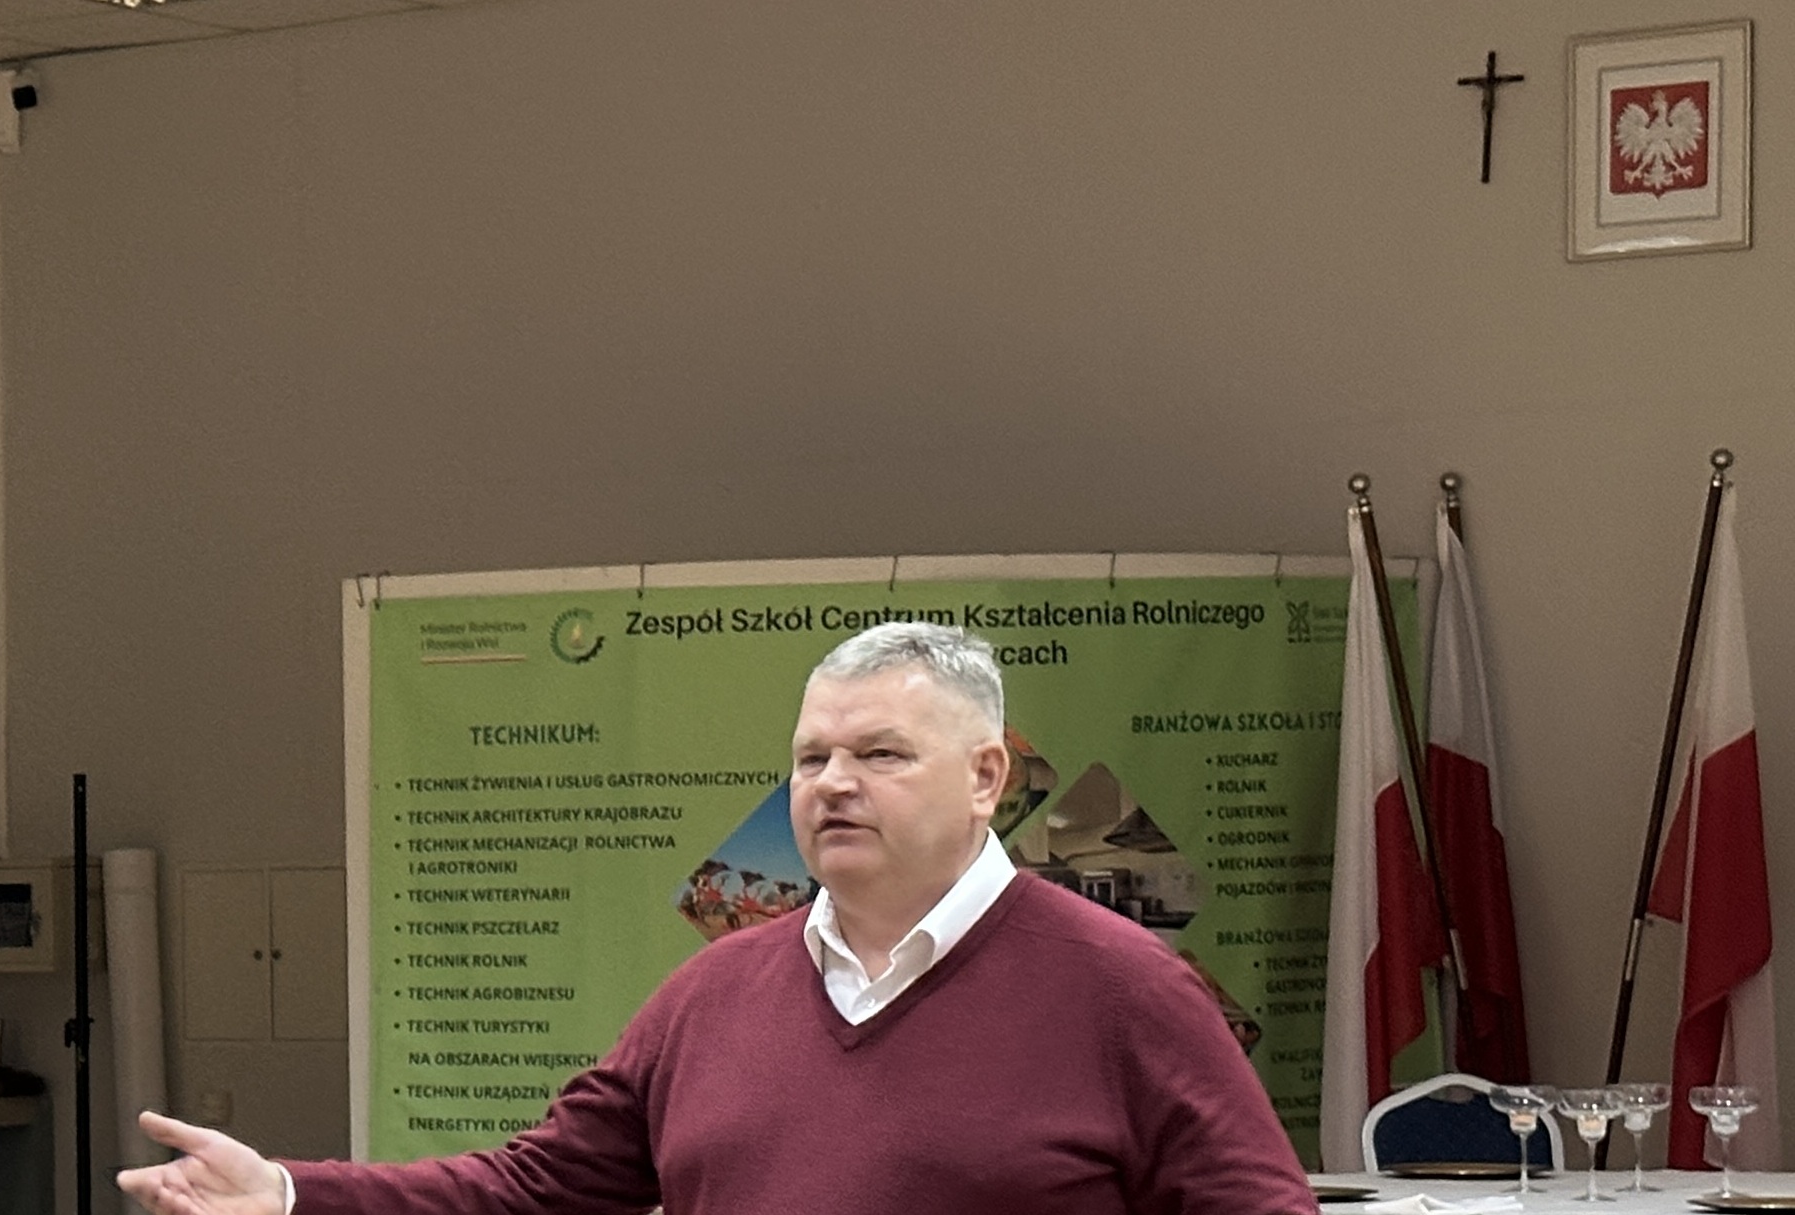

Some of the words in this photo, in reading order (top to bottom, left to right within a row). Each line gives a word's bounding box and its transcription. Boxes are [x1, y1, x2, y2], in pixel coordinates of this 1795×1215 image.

[626, 607, 723, 639] Zespół
[731, 606, 812, 632] Szkół
[963, 601, 1126, 628] Kształcenia
[1133, 600, 1265, 629] Rolniczego
[993, 640, 1068, 665] cach
[1131, 710, 1233, 734] BRANŻOWA
[1238, 712, 1305, 732] SZKOŁA
[470, 723, 600, 746] TECHNIKUM:
[1216, 753, 1279, 768] KUCHARZ
[408, 777, 469, 792] TECHNIK
[472, 775, 543, 791] ŻYWIENIA
[555, 774, 604, 790] USŁUG
[607, 771, 779, 788] GASTRONOMICZNYCH
[1217, 779, 1267, 794] ROLNIK
[408, 810, 470, 825] TECHNIK
[472, 808, 581, 824] ARCHITEKTURY
[584, 806, 682, 824] KRAJOBRAZU
[1217, 805, 1288, 820] CUKIERNIK
[408, 838, 470, 853] TECHNIK
[472, 837, 578, 853] MECHANIZACJI
[585, 834, 676, 850] ROLNICTWA
[1217, 831, 1290, 846] OGRODNIK
[417, 861, 517, 875] AGROTRONIKI
[1217, 856, 1288, 871] MECHANIK
[408, 889, 470, 902] TECHNIK
[471, 887, 570, 902] WETERYNARII
[1216, 881, 1287, 899] POJAZDÓW
[407, 922, 470, 936] TECHNIK
[472, 921, 560, 935] PSZCZELARZ
[407, 954, 470, 968] TECHNIK
[472, 954, 527, 968] ROLNIK
[407, 987, 470, 1001] TECHNIK
[472, 987, 575, 1001] AGROBIZNESU
[407, 1020, 469, 1033] TECHNIK
[473, 1020, 550, 1033] TURYSTYKI
[408, 1053, 430, 1066] NA
[434, 1052, 520, 1067] OBSZARACH
[524, 1053, 598, 1070] WIEJSKICH
[407, 1085, 470, 1099] TECHNIK
[473, 1083, 550, 1102] URZĄDZEŃ
[408, 1117, 495, 1132] ENERGETYKI
